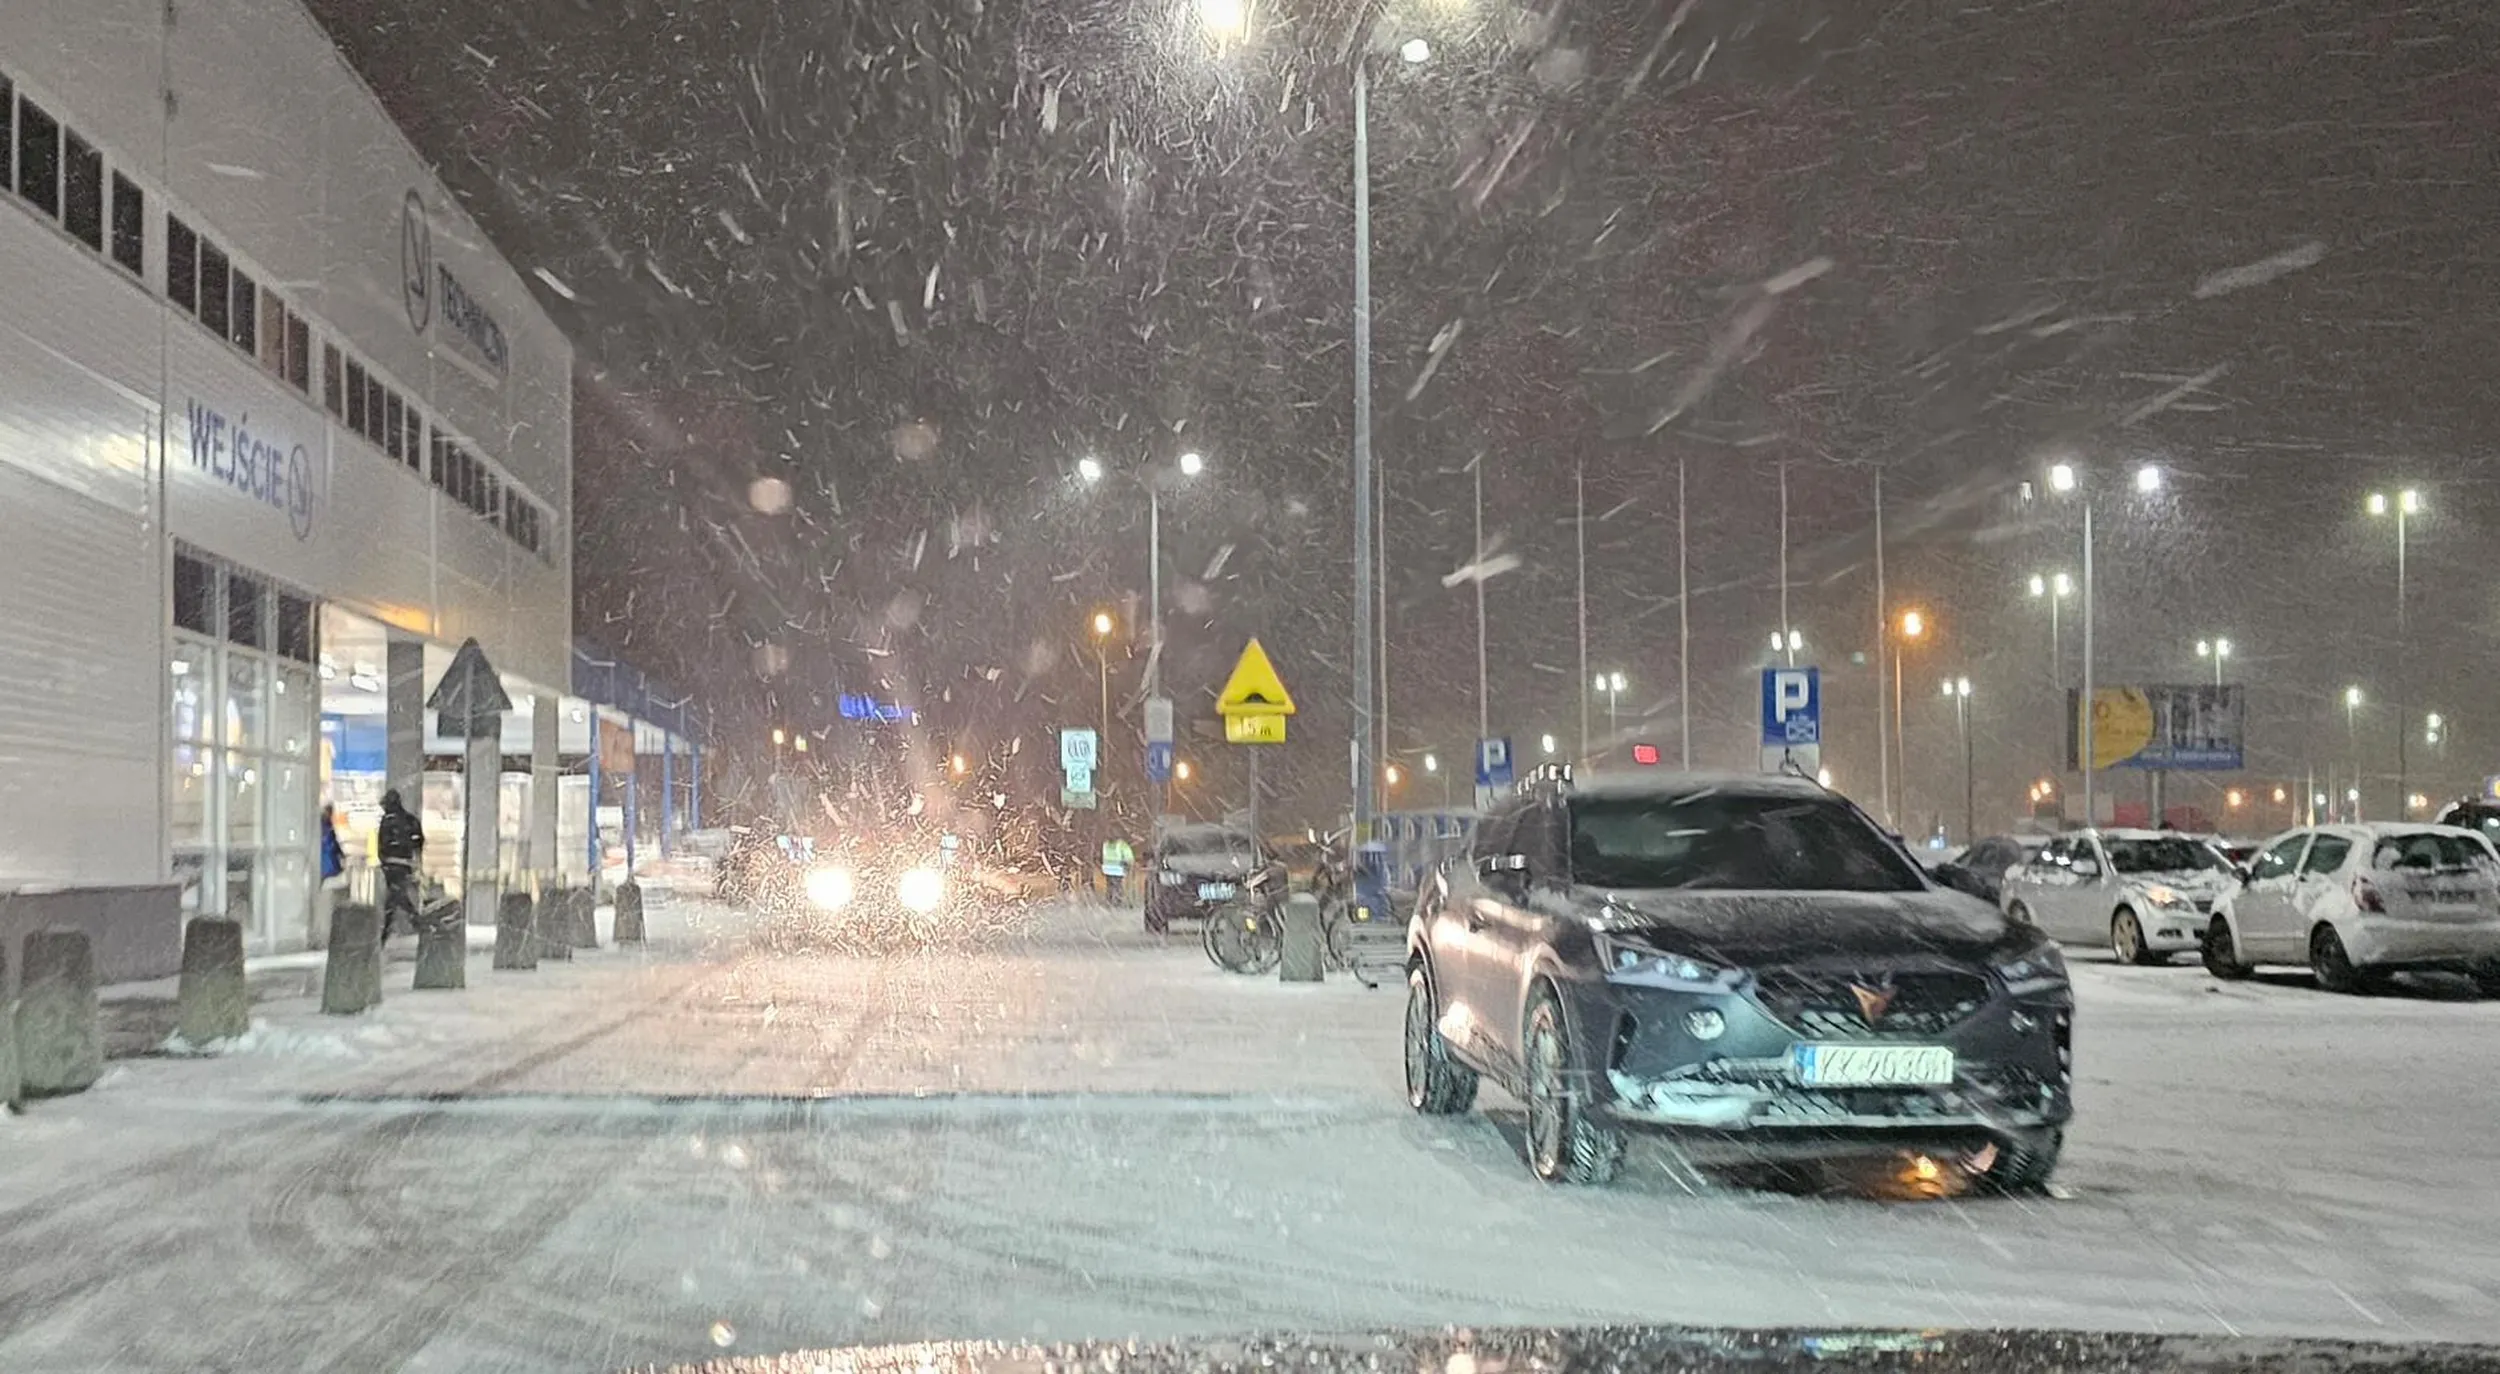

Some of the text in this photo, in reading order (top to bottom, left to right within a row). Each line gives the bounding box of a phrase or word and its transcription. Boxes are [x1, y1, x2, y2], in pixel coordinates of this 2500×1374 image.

[188, 397, 283, 508] WEJŚCIE
[1775, 671, 1808, 723] P
[1483, 740, 1506, 774] P
